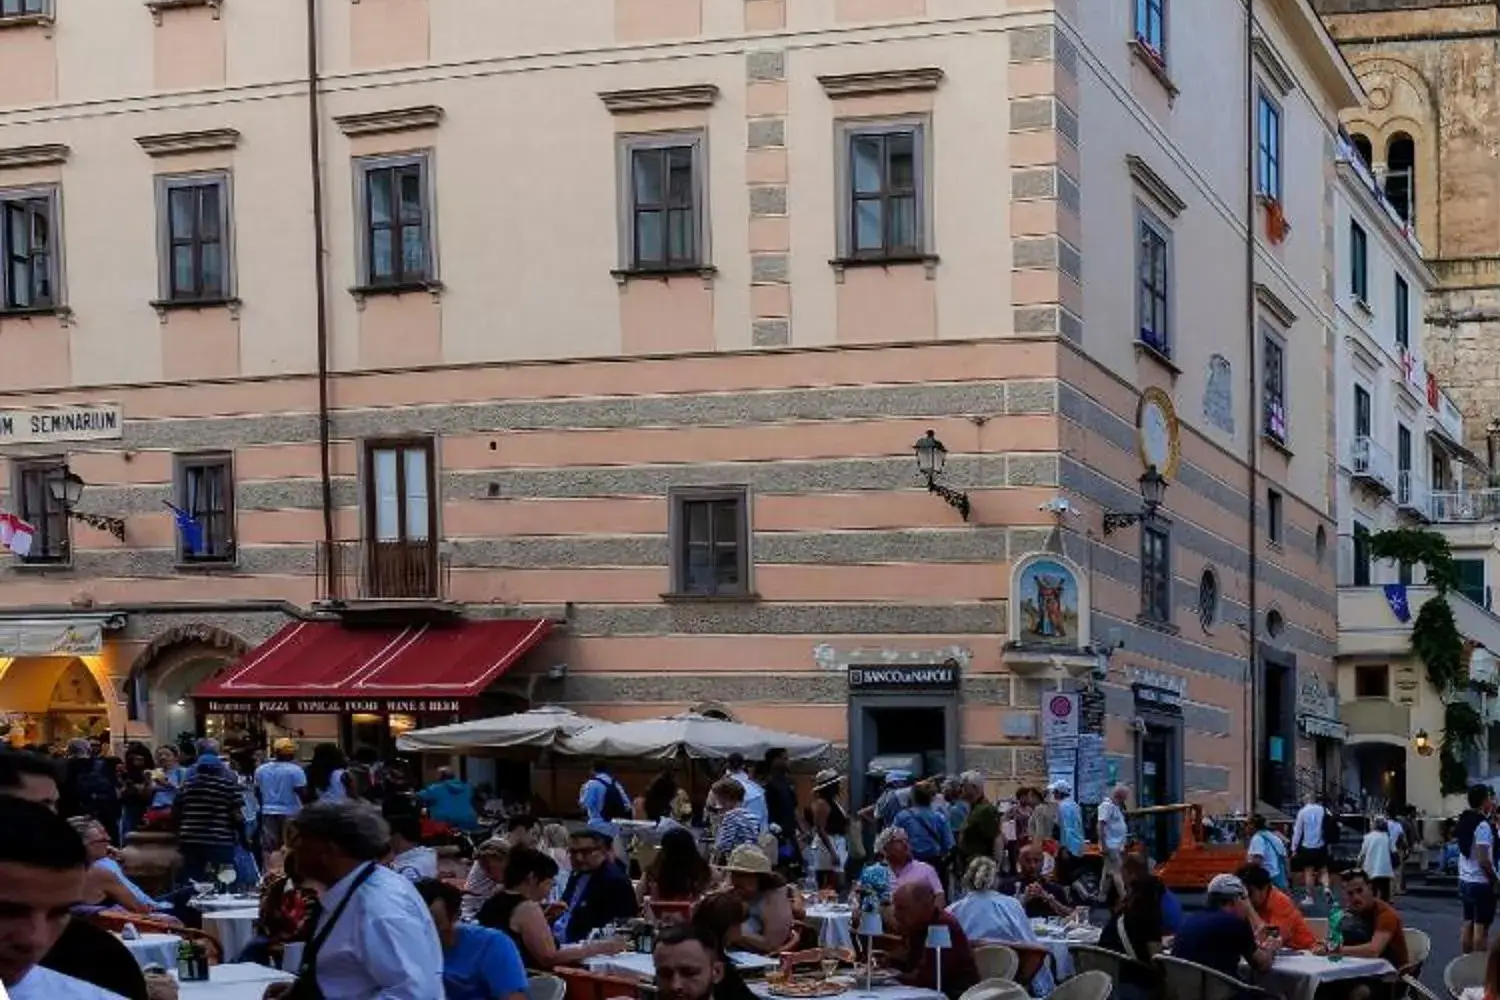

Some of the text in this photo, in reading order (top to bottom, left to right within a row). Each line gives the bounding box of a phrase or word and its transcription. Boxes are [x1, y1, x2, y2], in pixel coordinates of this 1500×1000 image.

[31, 411, 116, 434] SEMINARIUM
[863, 669, 902, 683] BANCO
[911, 668, 952, 682] NAPOLI
[259, 701, 289, 711] PIZZA
